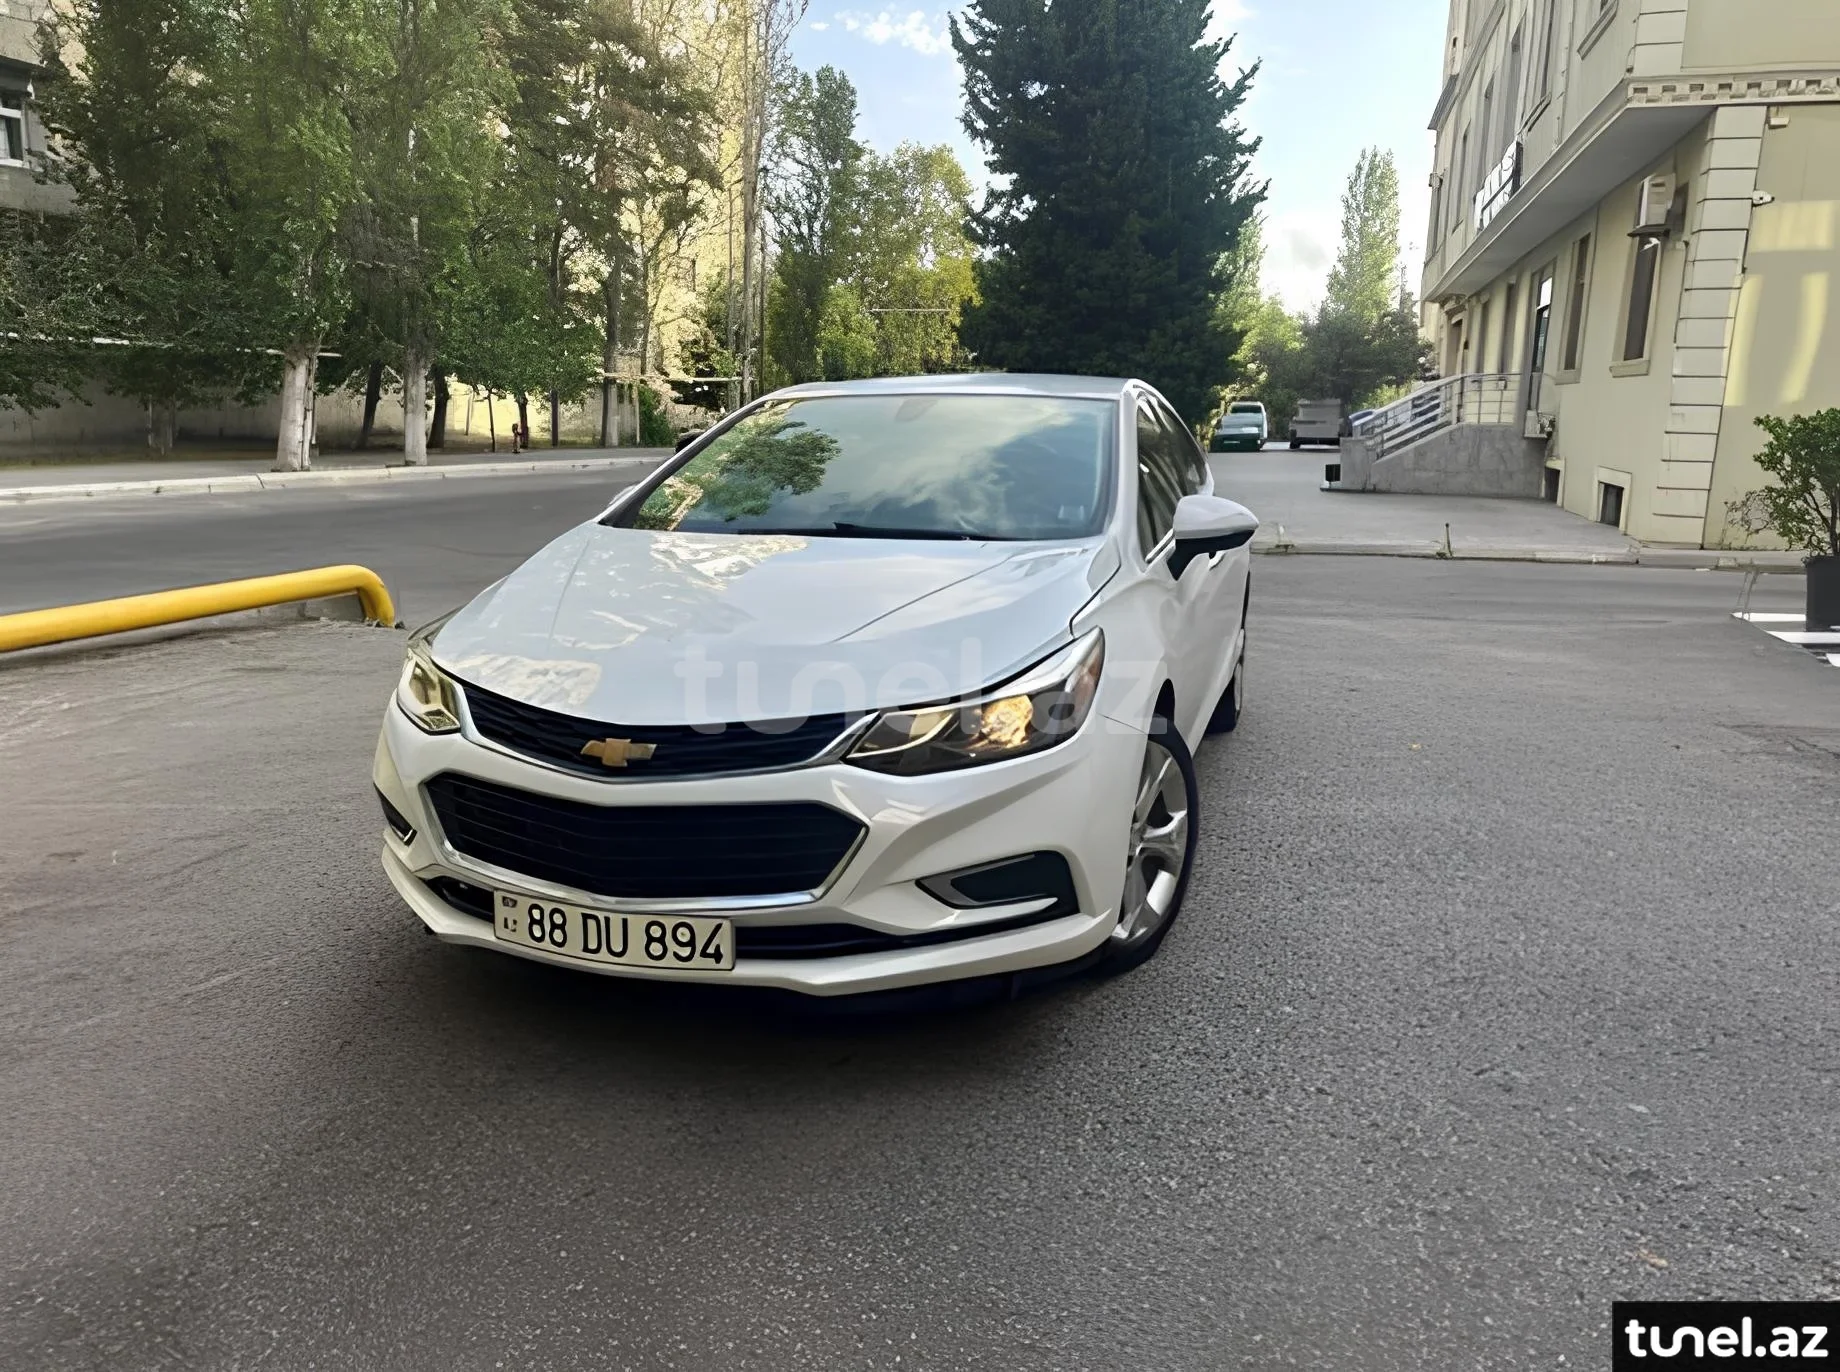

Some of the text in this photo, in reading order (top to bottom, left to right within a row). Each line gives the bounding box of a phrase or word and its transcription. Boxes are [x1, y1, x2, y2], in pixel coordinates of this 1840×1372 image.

[527, 903, 724, 964] 88 DU 894
